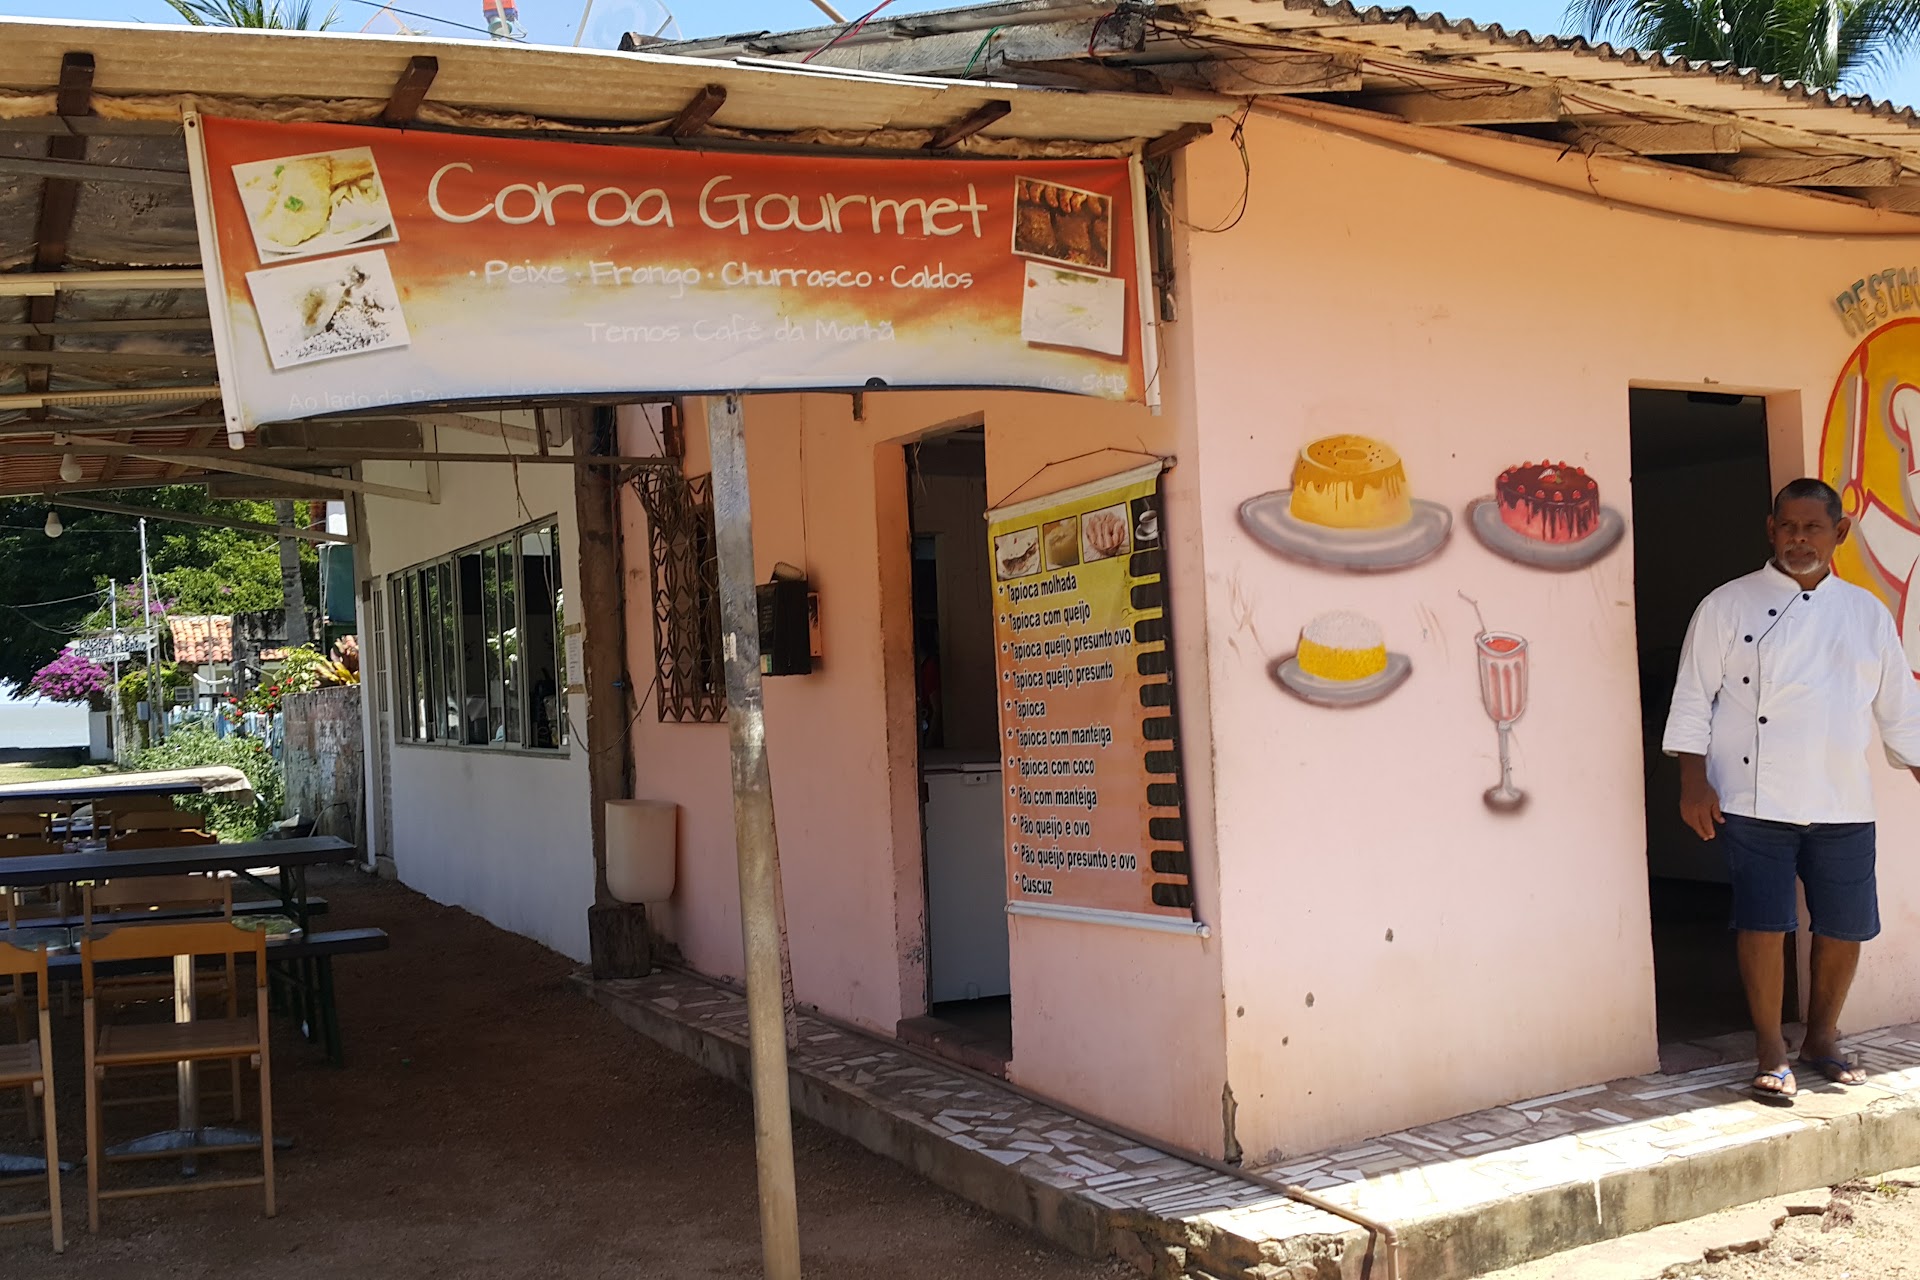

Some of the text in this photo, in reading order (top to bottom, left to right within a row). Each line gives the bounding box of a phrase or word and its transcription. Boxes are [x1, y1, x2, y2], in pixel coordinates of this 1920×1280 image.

[428, 162, 988, 238] Coroa Gourmet
[484, 259, 973, 299] Peixe Frango Churrasco Caldos
[584, 313, 895, 343] Temos Café da Manhã
[288, 392, 319, 412] Ao
[325, 391, 370, 410] lado
[1007, 572, 1077, 605] Tapioca molhada
[1009, 600, 1091, 634] Tapioca com queijo
[1011, 628, 1132, 663] Tapioca queijo presunto ovo
[1013, 660, 1113, 692] Tapioca queijo presunto
[1014, 699, 1046, 721] Tapioca
[1016, 723, 1112, 751] Tapioca com manteiga
[1018, 757, 1094, 779] Tapioca com coco
[1034, 789, 1052, 805] com
[1056, 786, 1097, 810] manteiga
[1036, 816, 1062, 839] queijo
[1065, 820, 1071, 835] e
[1074, 821, 1090, 836] ovo
[1038, 847, 1064, 869] queijo
[1068, 848, 1107, 870] presunto
[1111, 854, 1117, 868] e
[1119, 854, 1136, 870] ovo
[1022, 873, 1052, 895] Cuscuz
